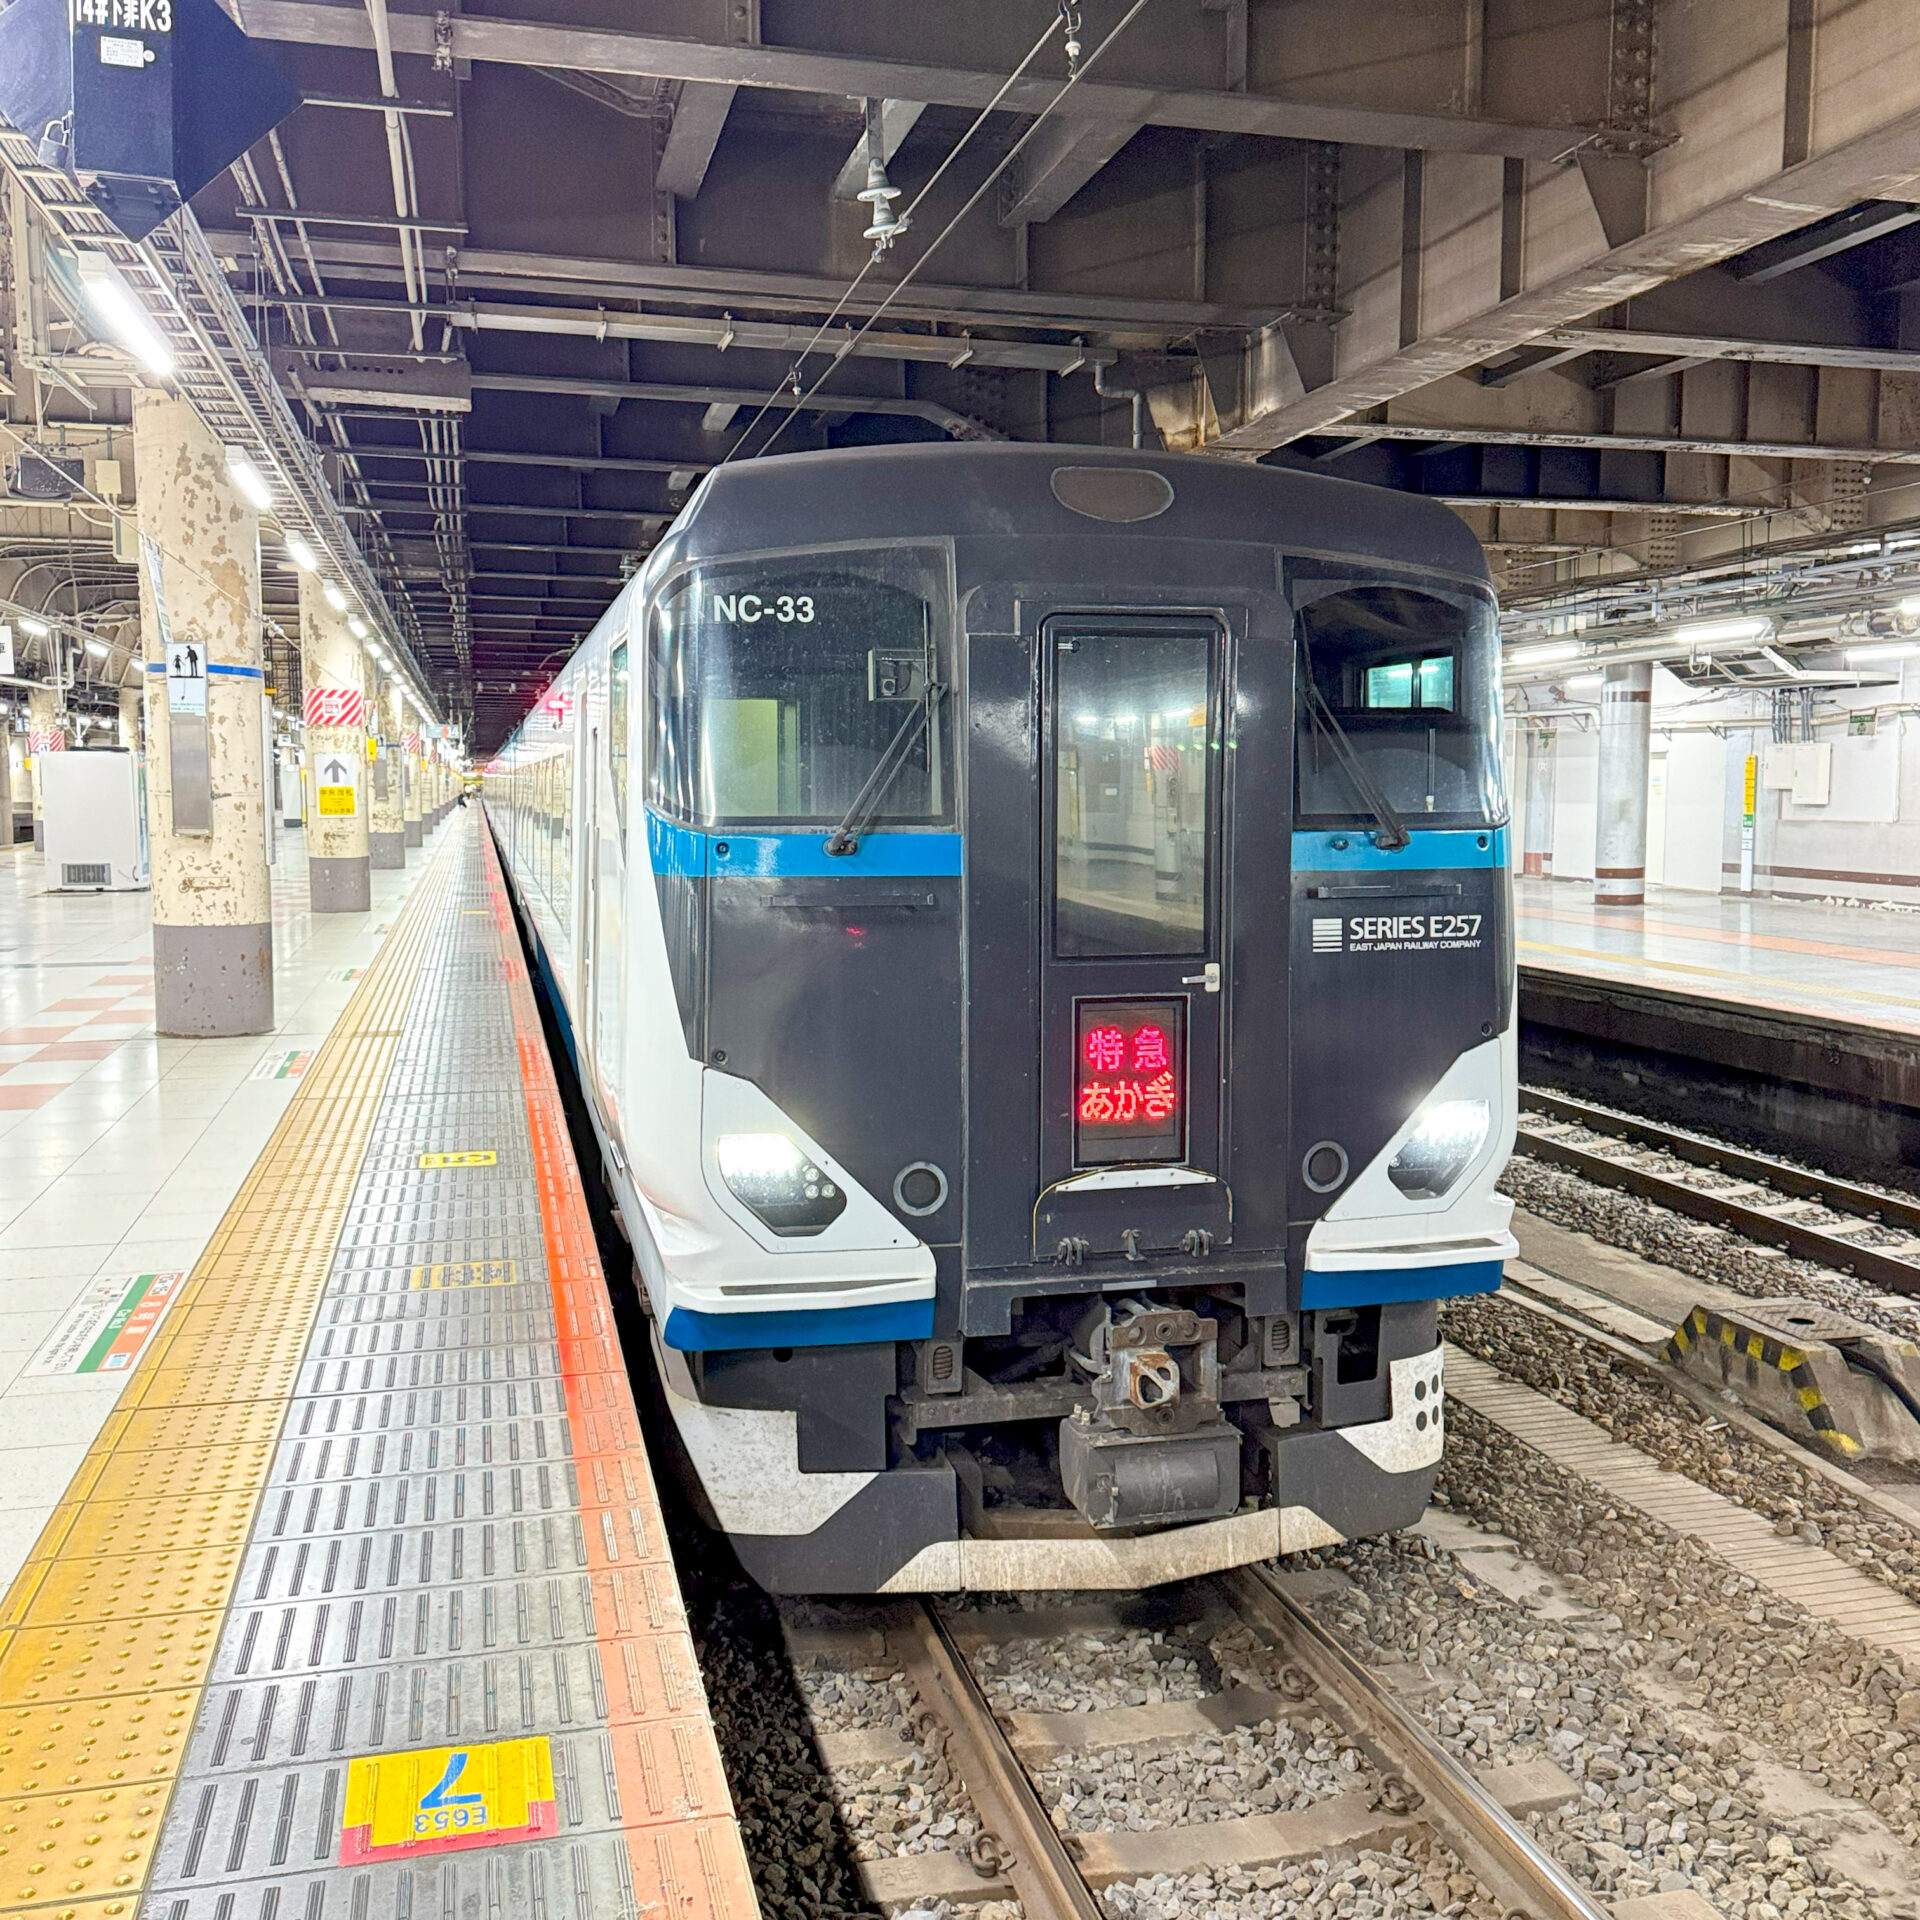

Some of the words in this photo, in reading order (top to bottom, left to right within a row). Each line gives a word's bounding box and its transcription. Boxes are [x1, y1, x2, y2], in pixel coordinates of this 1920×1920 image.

[713, 594, 815, 623] NC-33
[1350, 916, 1425, 940] SERIES
[1429, 914, 1482, 938] E257
[1350, 942, 1373, 952] EAST
[1373, 942, 1402, 951] JAPAN
[1404, 941, 1439, 950] RAILWAY
[1440, 939, 1482, 949] COMPANY
[1089, 1029, 1167, 1070] 特急
[1081, 1071, 1175, 1119] あかぎ
[420, 1752, 482, 1809] 7
[414, 1805, 487, 1833] E653
